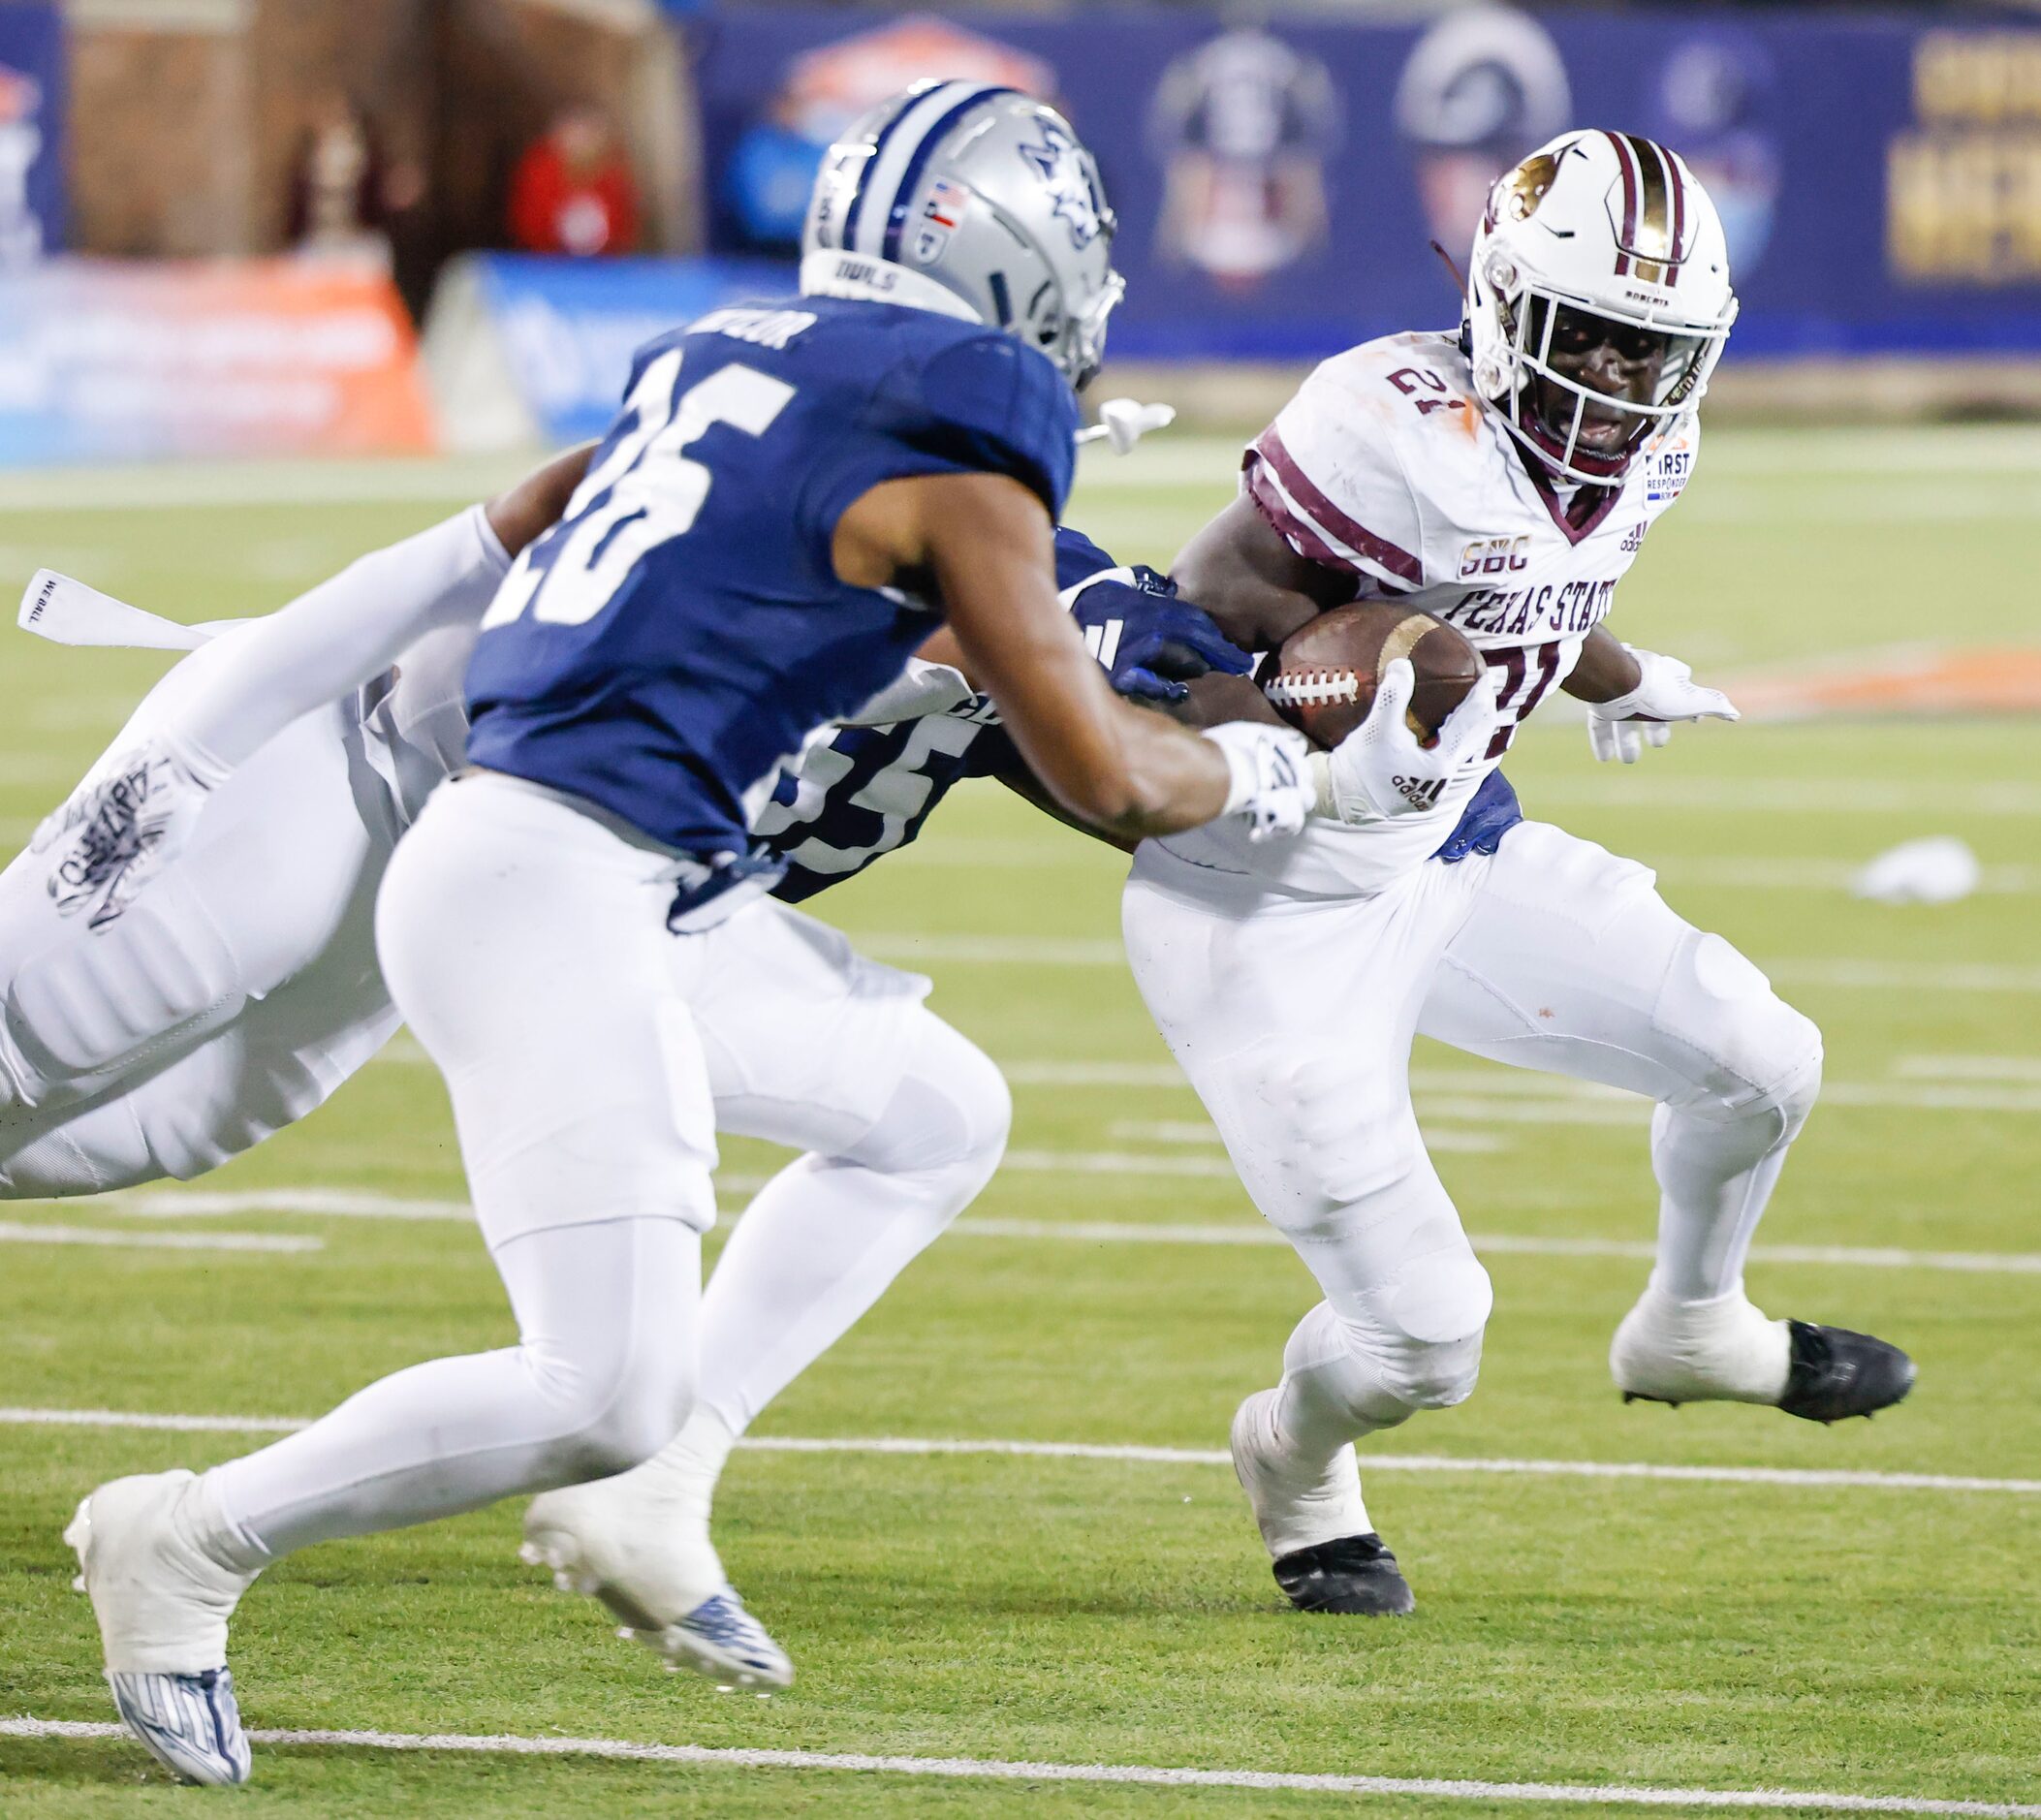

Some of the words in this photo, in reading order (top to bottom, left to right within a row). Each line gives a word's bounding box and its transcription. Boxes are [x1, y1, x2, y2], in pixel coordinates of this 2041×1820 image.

[1461, 534, 1532, 577] SBC
[41, 580, 57, 599] WE
[1444, 586, 1553, 635] TEXAS
[1392, 775, 1429, 812] adidas
